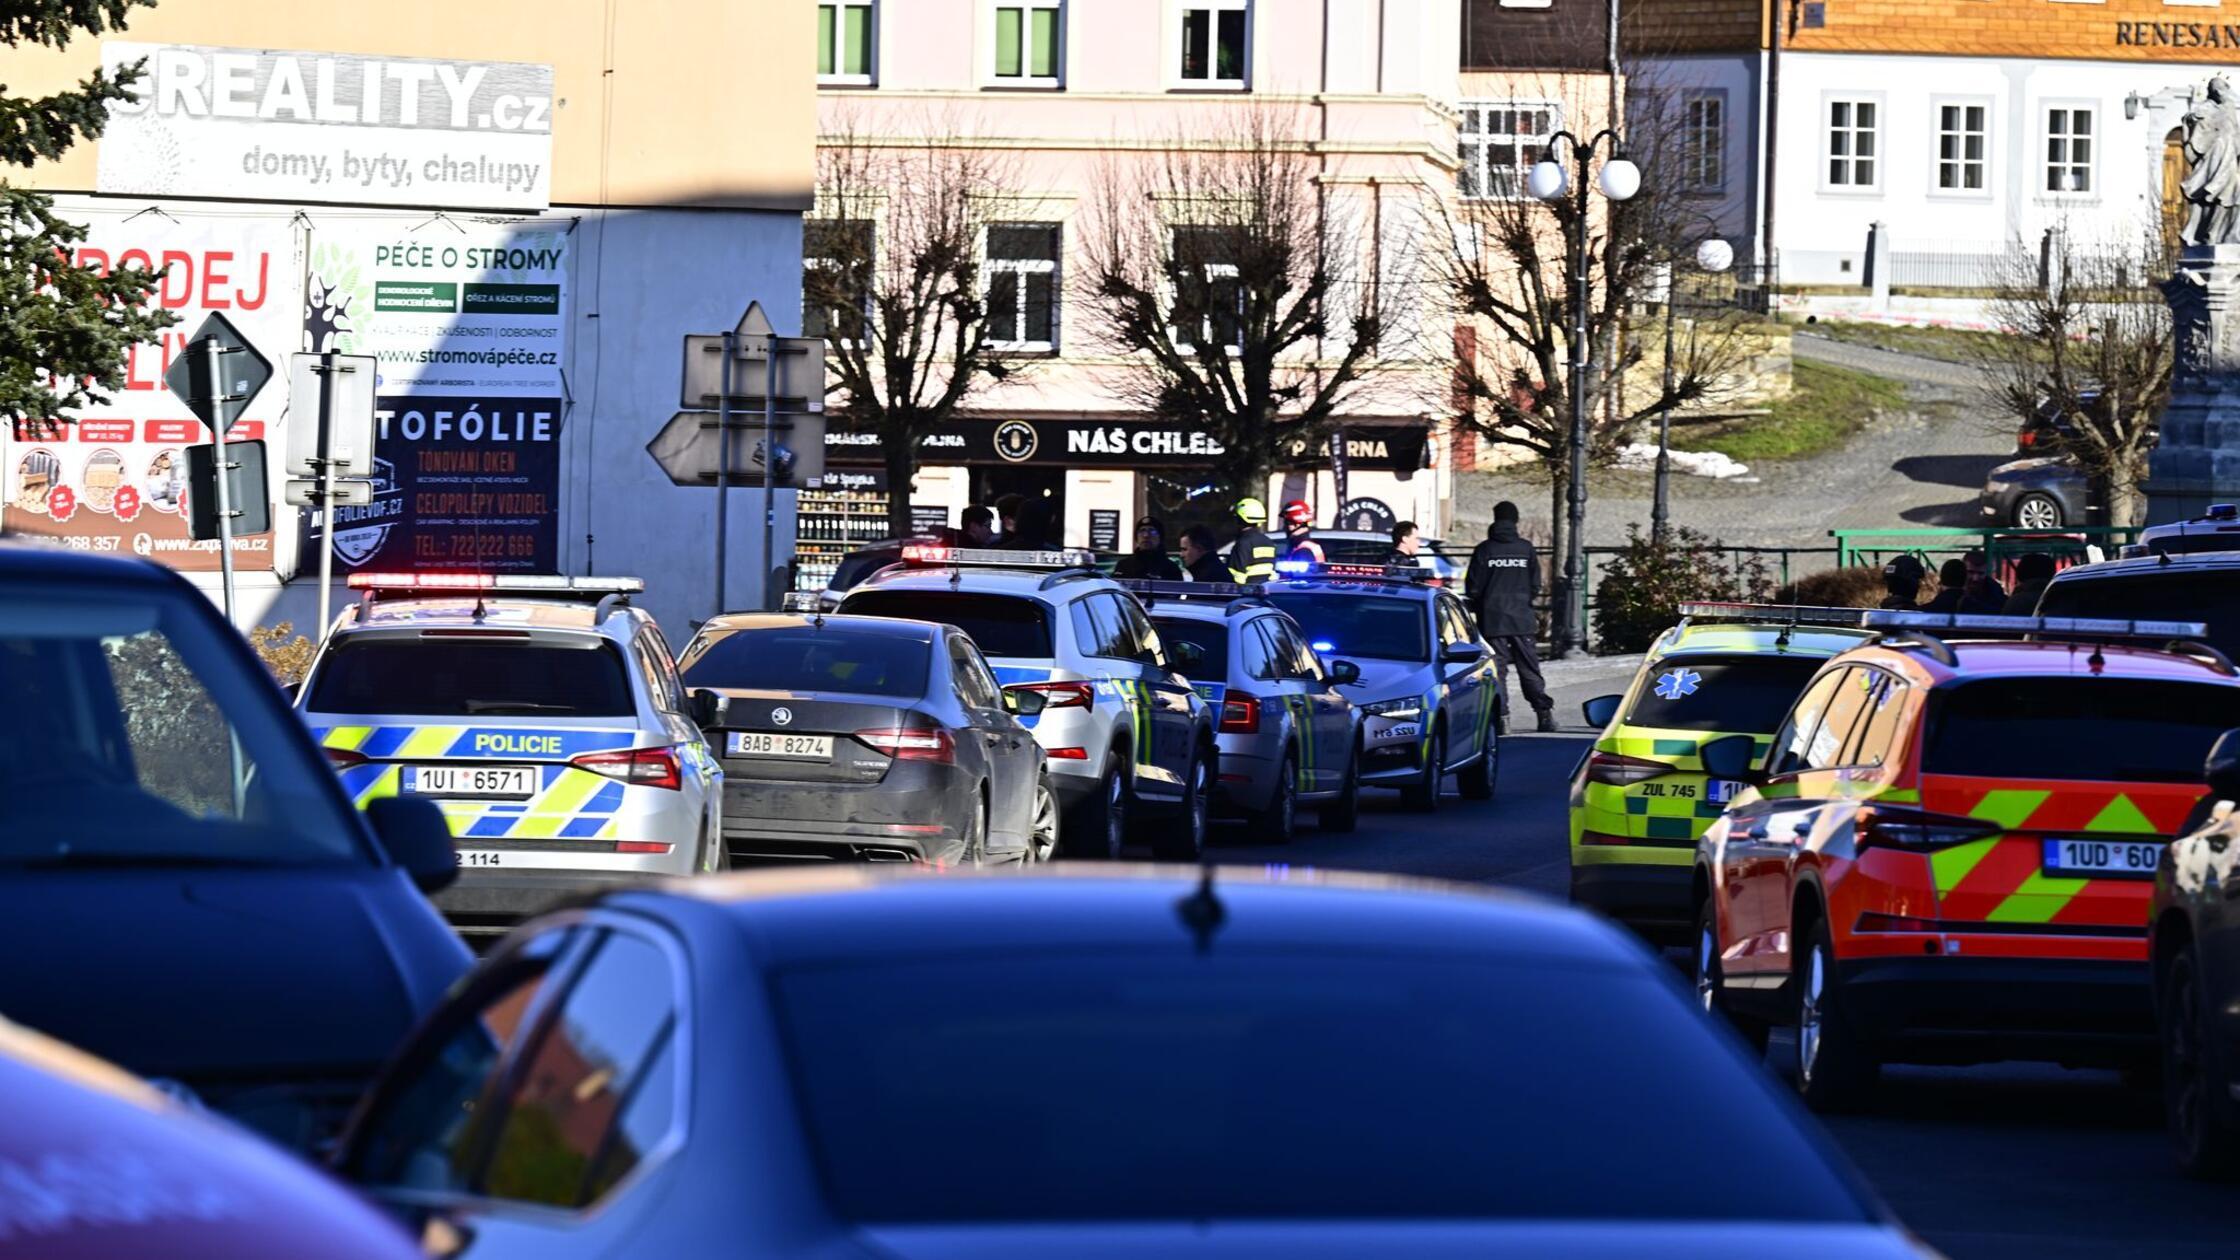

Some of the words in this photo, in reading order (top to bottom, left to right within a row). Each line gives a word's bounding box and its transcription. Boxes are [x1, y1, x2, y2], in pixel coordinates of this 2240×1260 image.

[242, 145, 331, 184] domy,
[343, 149, 412, 188] byty,
[423, 153, 540, 193] chalupy
[376, 240, 433, 268] PÉČE
[441, 247, 458, 268] O
[466, 248, 562, 270] STROMY
[35, 247, 269, 311] RODEJ
[500, 327, 557, 339] ODBORNOST
[373, 348, 557, 368] www.stromovápéče.cz
[1067, 427, 1127, 454] NÁŠ
[484, 449, 516, 472] OKEN
[311, 498, 403, 528] AUOFOLIEVDF.CZ
[416, 493, 496, 514] CELOPOLEPY
[499, 494, 548, 514] VOZIDEL
[93, 536, 122, 552] 357
[451, 535, 475, 556] 722
[480, 535, 505, 556] 222
[509, 536, 534, 556] 666
[1488, 559, 1528, 568] POLICE
[475, 734, 562, 753] POLICIE
[743, 735, 771, 752] 8AB
[784, 738, 824, 754] 8274
[422, 770, 454, 789] 1UI
[474, 771, 522, 790] 6571
[1642, 783, 1666, 797] ZUL
[1671, 784, 1696, 798] 745
[470, 853, 500, 866] 114
[2066, 843, 2109, 867] 1UD
[2127, 845, 2161, 868] 60
